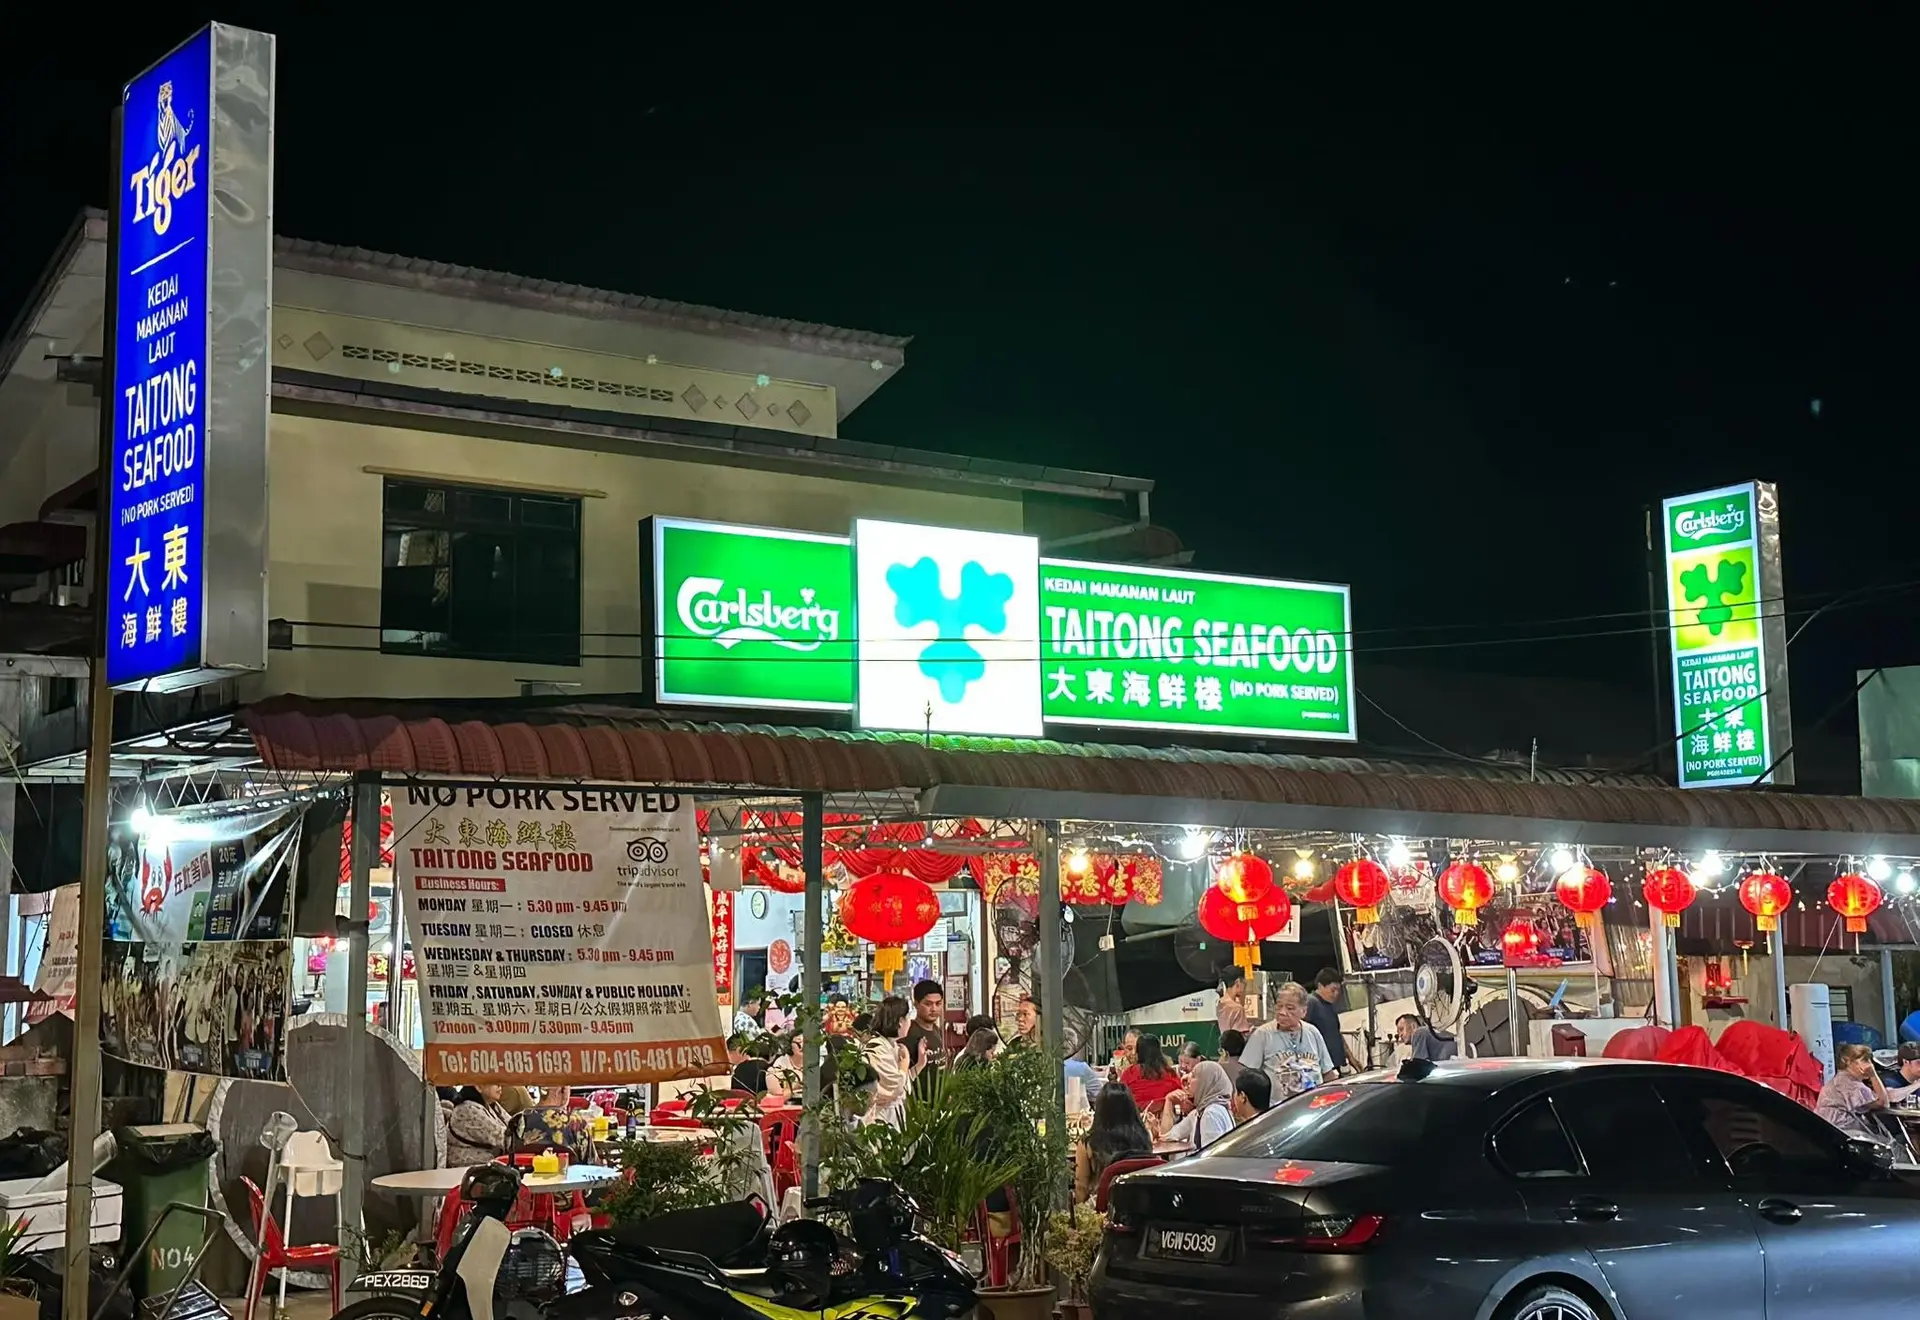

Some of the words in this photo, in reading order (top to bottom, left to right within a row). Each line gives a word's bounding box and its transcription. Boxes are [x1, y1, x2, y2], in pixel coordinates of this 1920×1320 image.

[130, 142, 200, 236] Tiger
[147, 273, 179, 309] KEDAI
[136, 296, 188, 342] MAKANAN
[148, 332, 176, 365] LAUT
[125, 359, 196, 441] TAITONG
[123, 423, 195, 492] SEAFOOD
[137, 496, 160, 520] PORK
[1675, 509, 1745, 538] Carlsberg
[123, 524, 189, 602] 大東
[1044, 577, 1087, 595] KEDAI
[1090, 580, 1159, 602] MAKANAN
[1162, 588, 1196, 605] LAUT
[677, 576, 840, 641] Carlsberg
[1045, 605, 1184, 664] TAITONG
[1192, 617, 1338, 674] SEAFOOD
[1682, 663, 1757, 691] TAITONG
[1230, 679, 1253, 699] (NO
[1255, 682, 1289, 699] PORK
[1290, 685, 1339, 705] SERVED)
[1684, 685, 1758, 706] SEAFOOD
[1686, 760, 1701, 773] (NO
[1702, 758, 1727, 770] PORK
[1727, 754, 1762, 767] SERVED)
[408, 786, 457, 807] NO
[466, 787, 556, 811] PORK
[562, 790, 681, 813] SERVED
[410, 847, 497, 870] TAITONG
[502, 851, 593, 872] SEAFOOD
[420, 877, 468, 891] Business
[468, 878, 500, 891] Hours:
[418, 898, 466, 912] MONDAY
[527, 900, 553, 913] 5.30
[555, 901, 574, 913] pm
[583, 900, 609, 913] 9.45
[421, 922, 471, 937] TUESDAY
[531, 925, 573, 938] CLOSED
[577, 924, 606, 939] 休息
[424, 947, 493, 962] WEDNESDAY
[496, 951, 504, 961] &
[506, 949, 565, 962] THURSDAY
[577, 947, 600, 962] 5.30
[602, 949, 621, 963] pm
[629, 948, 654, 962] 9.45
[656, 949, 675, 963] pm
[426, 963, 469, 978] 星期三
[541, 984, 582, 999] SUNDAY
[586, 988, 594, 998] &
[595, 985, 636, 999] PUBLIC
[637, 984, 684, 999] HOLIDAY
[432, 1020, 476, 1034] 12noon
[485, 1020, 530, 1035] 3.00pm
[539, 1020, 582, 1036] 5.30pm
[591, 1020, 634, 1035] 9.45pm
[1160, 1033, 1186, 1048] LAUT
[439, 1050, 467, 1074] Tel:
[470, 1049, 534, 1074] 604-885
[536, 1050, 572, 1074] 1693
[580, 1049, 612, 1074] H/P:
[614, 1047, 674, 1072] 016-481
[1161, 1230, 1217, 1253] VGW5039
[364, 1273, 430, 1290] PEX2869
